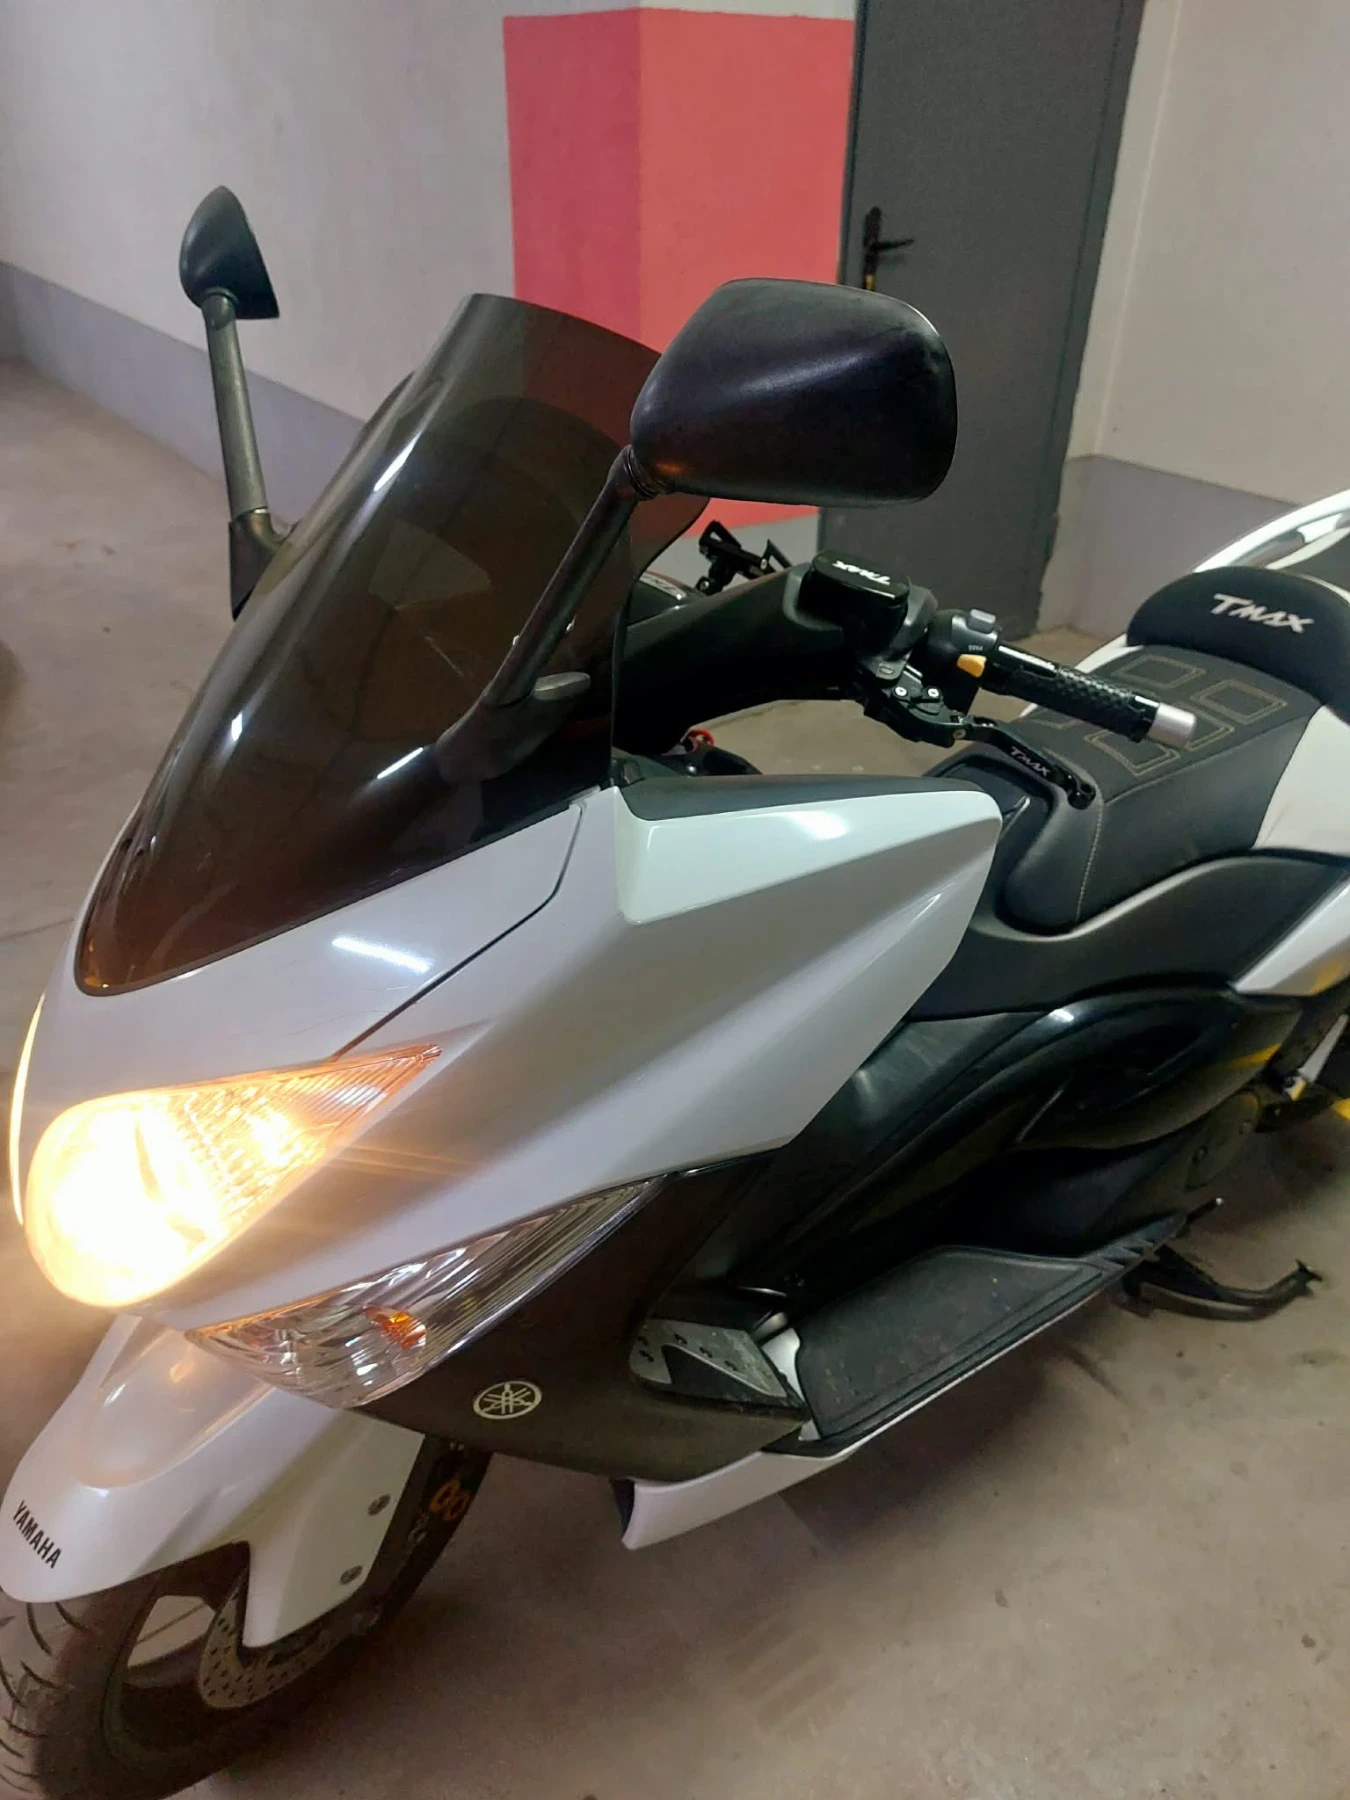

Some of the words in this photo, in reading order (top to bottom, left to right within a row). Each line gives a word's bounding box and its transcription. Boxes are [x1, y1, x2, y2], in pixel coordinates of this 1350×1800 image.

[1210, 593, 1314, 633] TMAX
[1011, 746, 1050, 777] TMAX
[13, 1500, 61, 1569] YAMAHA
